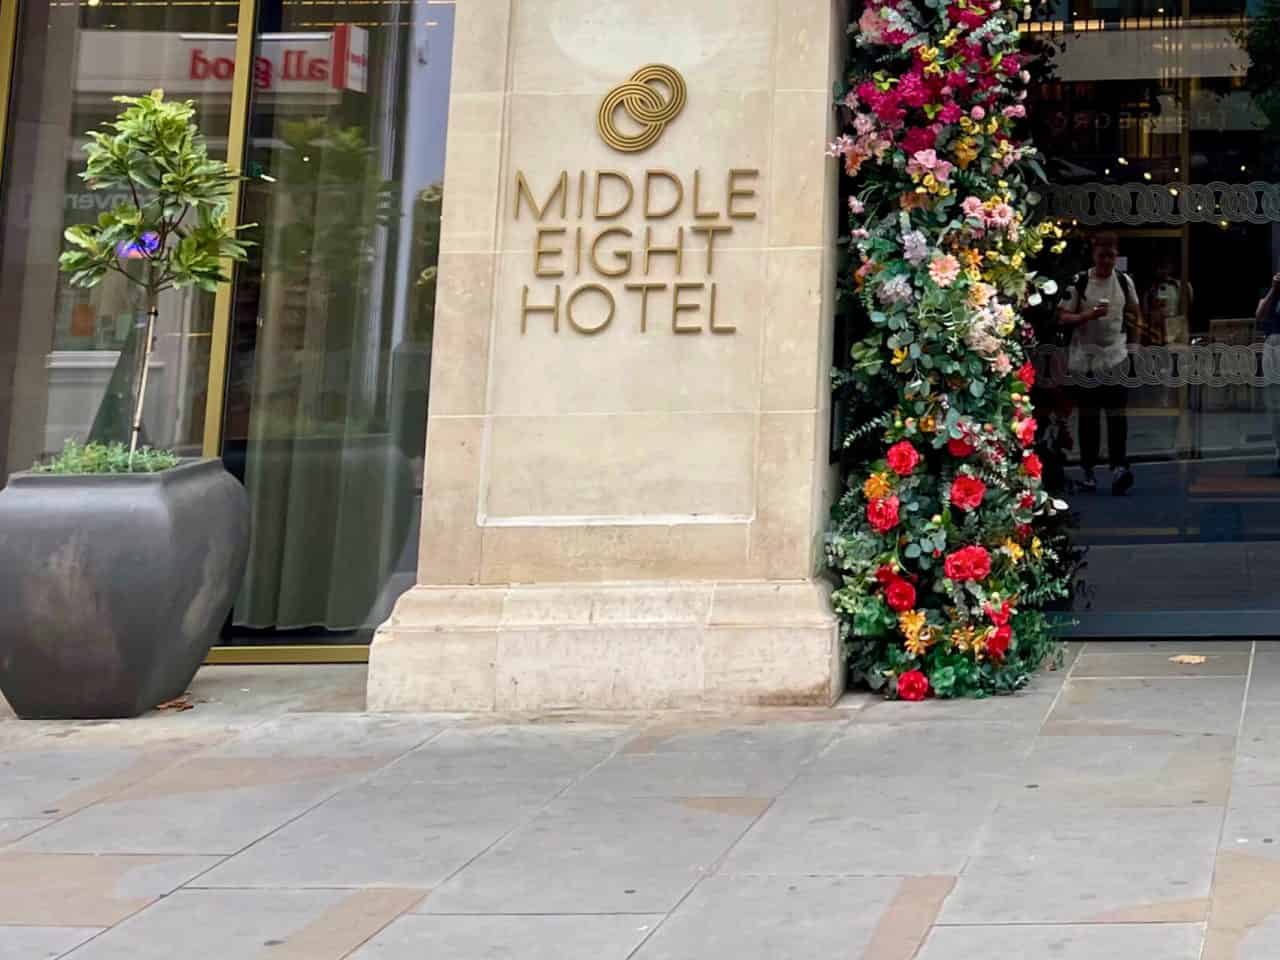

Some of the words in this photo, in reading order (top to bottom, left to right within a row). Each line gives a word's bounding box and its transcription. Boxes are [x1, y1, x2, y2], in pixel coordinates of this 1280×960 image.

[513, 169, 759, 221] MIDDLE
[534, 226, 733, 278] EIGHT
[520, 283, 737, 334] HOTEL
